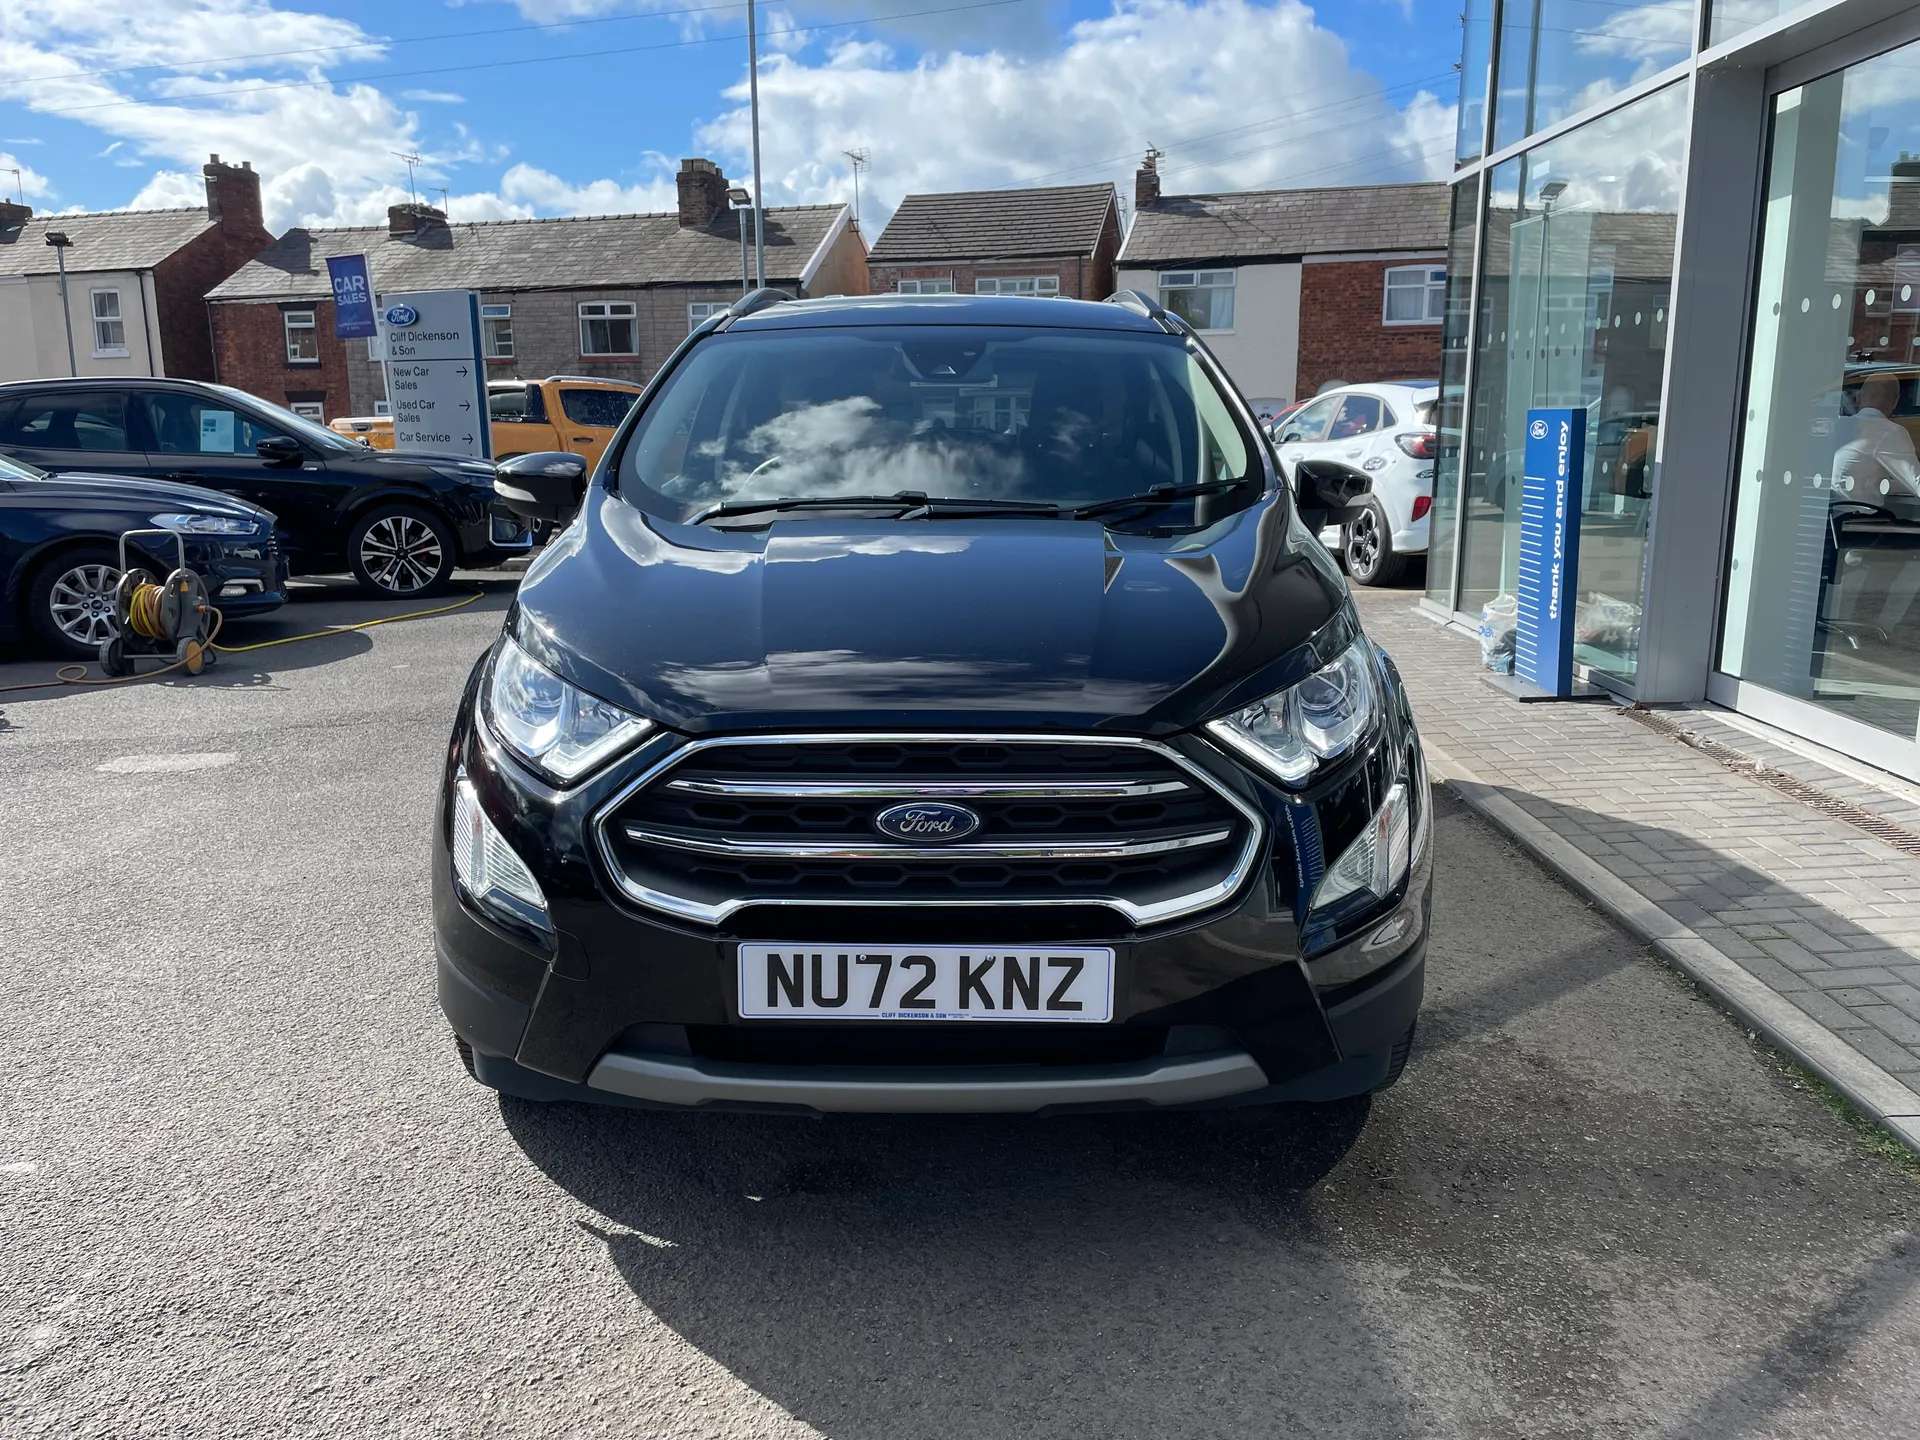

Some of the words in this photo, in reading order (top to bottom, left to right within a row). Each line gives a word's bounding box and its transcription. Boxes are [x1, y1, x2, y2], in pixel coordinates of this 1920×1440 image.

[334, 275, 365, 293] CAR
[337, 292, 367, 306] SALES
[390, 332, 406, 342] Cliff
[408, 331, 460, 342] Dickenson
[391, 346, 397, 355] &
[398, 345, 416, 355] Son
[393, 367, 411, 377] New
[413, 366, 430, 377] Car
[394, 380, 418, 390] Sales
[396, 400, 417, 410] Used
[419, 400, 435, 410] Car
[398, 412, 421, 423] Sales
[399, 431, 413, 442] Car
[415, 432, 451, 442] Service
[1558, 420, 1569, 477] enjoy
[1555, 479, 1564, 520] and
[1554, 522, 1562, 559] you
[1549, 562, 1560, 619] thank
[767, 954, 937, 1009] NU72
[959, 955, 1084, 1012] KNZ
